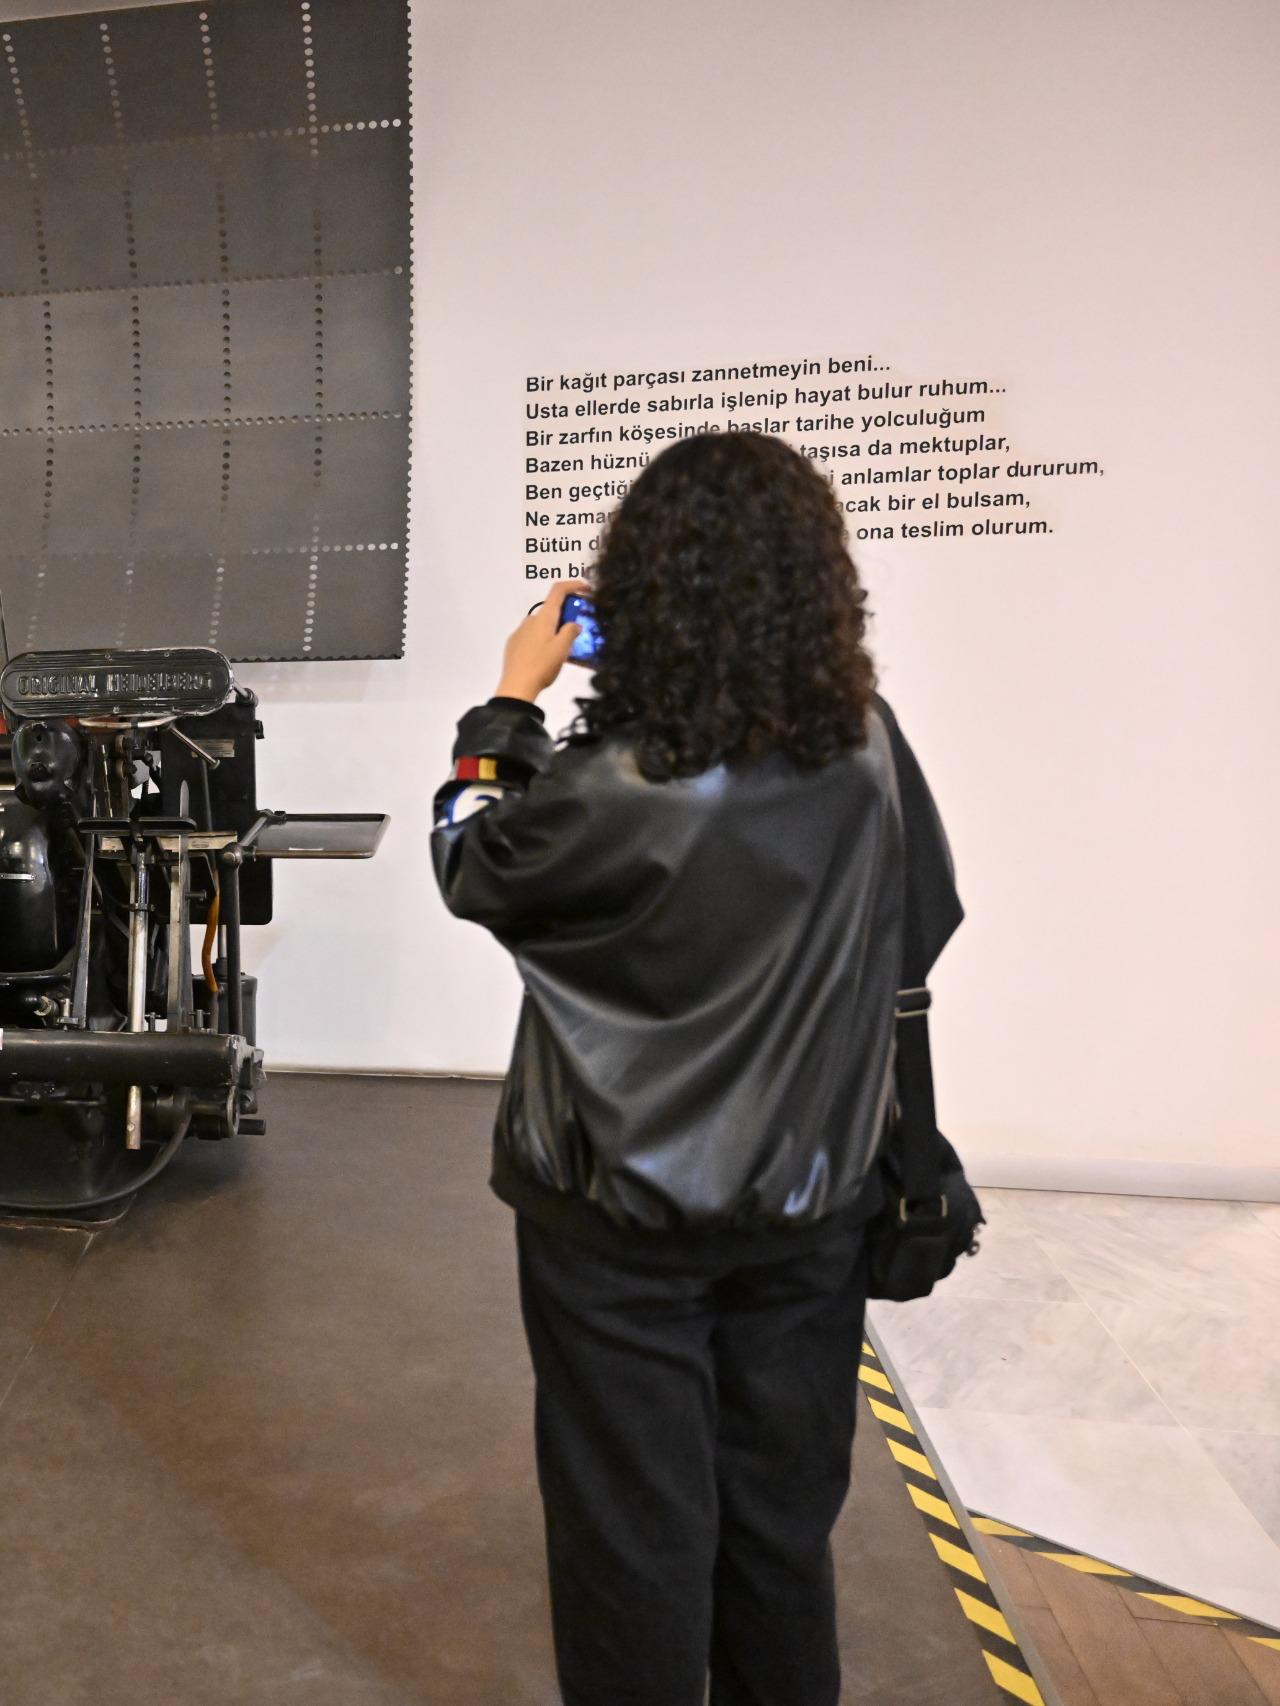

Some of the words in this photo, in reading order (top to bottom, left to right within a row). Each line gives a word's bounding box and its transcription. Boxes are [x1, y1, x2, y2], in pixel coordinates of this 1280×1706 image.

[526, 375, 554, 393] Bir
[560, 372, 608, 394] kağıt
[613, 370, 685, 392] parçası
[691, 358, 821, 383] zannetmeyin
[828, 354, 890, 374] beni...
[526, 403, 569, 420] Usta
[575, 397, 641, 417] ellerde
[647, 393, 714, 413] sabırla
[721, 389, 788, 412] işlenip
[795, 385, 851, 407] hayat
[857, 382, 913, 401] bulur
[919, 379, 1006, 397] ruhum...
[526, 430, 554, 447] Bir
[558, 426, 613, 445] zarfın
[795, 413, 855, 432] tarihe
[861, 407, 985, 433] yolculuğum
[525, 457, 584, 474] Bazen
[589, 451, 651, 471] hüznü
[798, 443, 862, 463] taşısa
[867, 439, 892, 456] da
[899, 434, 1010, 456] mektuplar,
[525, 484, 562, 501] Ben
[841, 466, 932, 486] anlamlar
[937, 462, 1001, 485] toplar
[1006, 460, 1104, 478] dururum,
[525, 511, 550, 527] Ne
[888, 494, 916, 511] bir
[921, 492, 940, 510] el
[947, 491, 1030, 509] bulsam,
[525, 536, 582, 554] Bütün
[856, 526, 894, 540] ona
[900, 520, 964, 539] teslim
[971, 518, 1053, 536] olurum.
[525, 564, 562, 580] Ben
[18, 673, 98, 695] ORIGINAL
